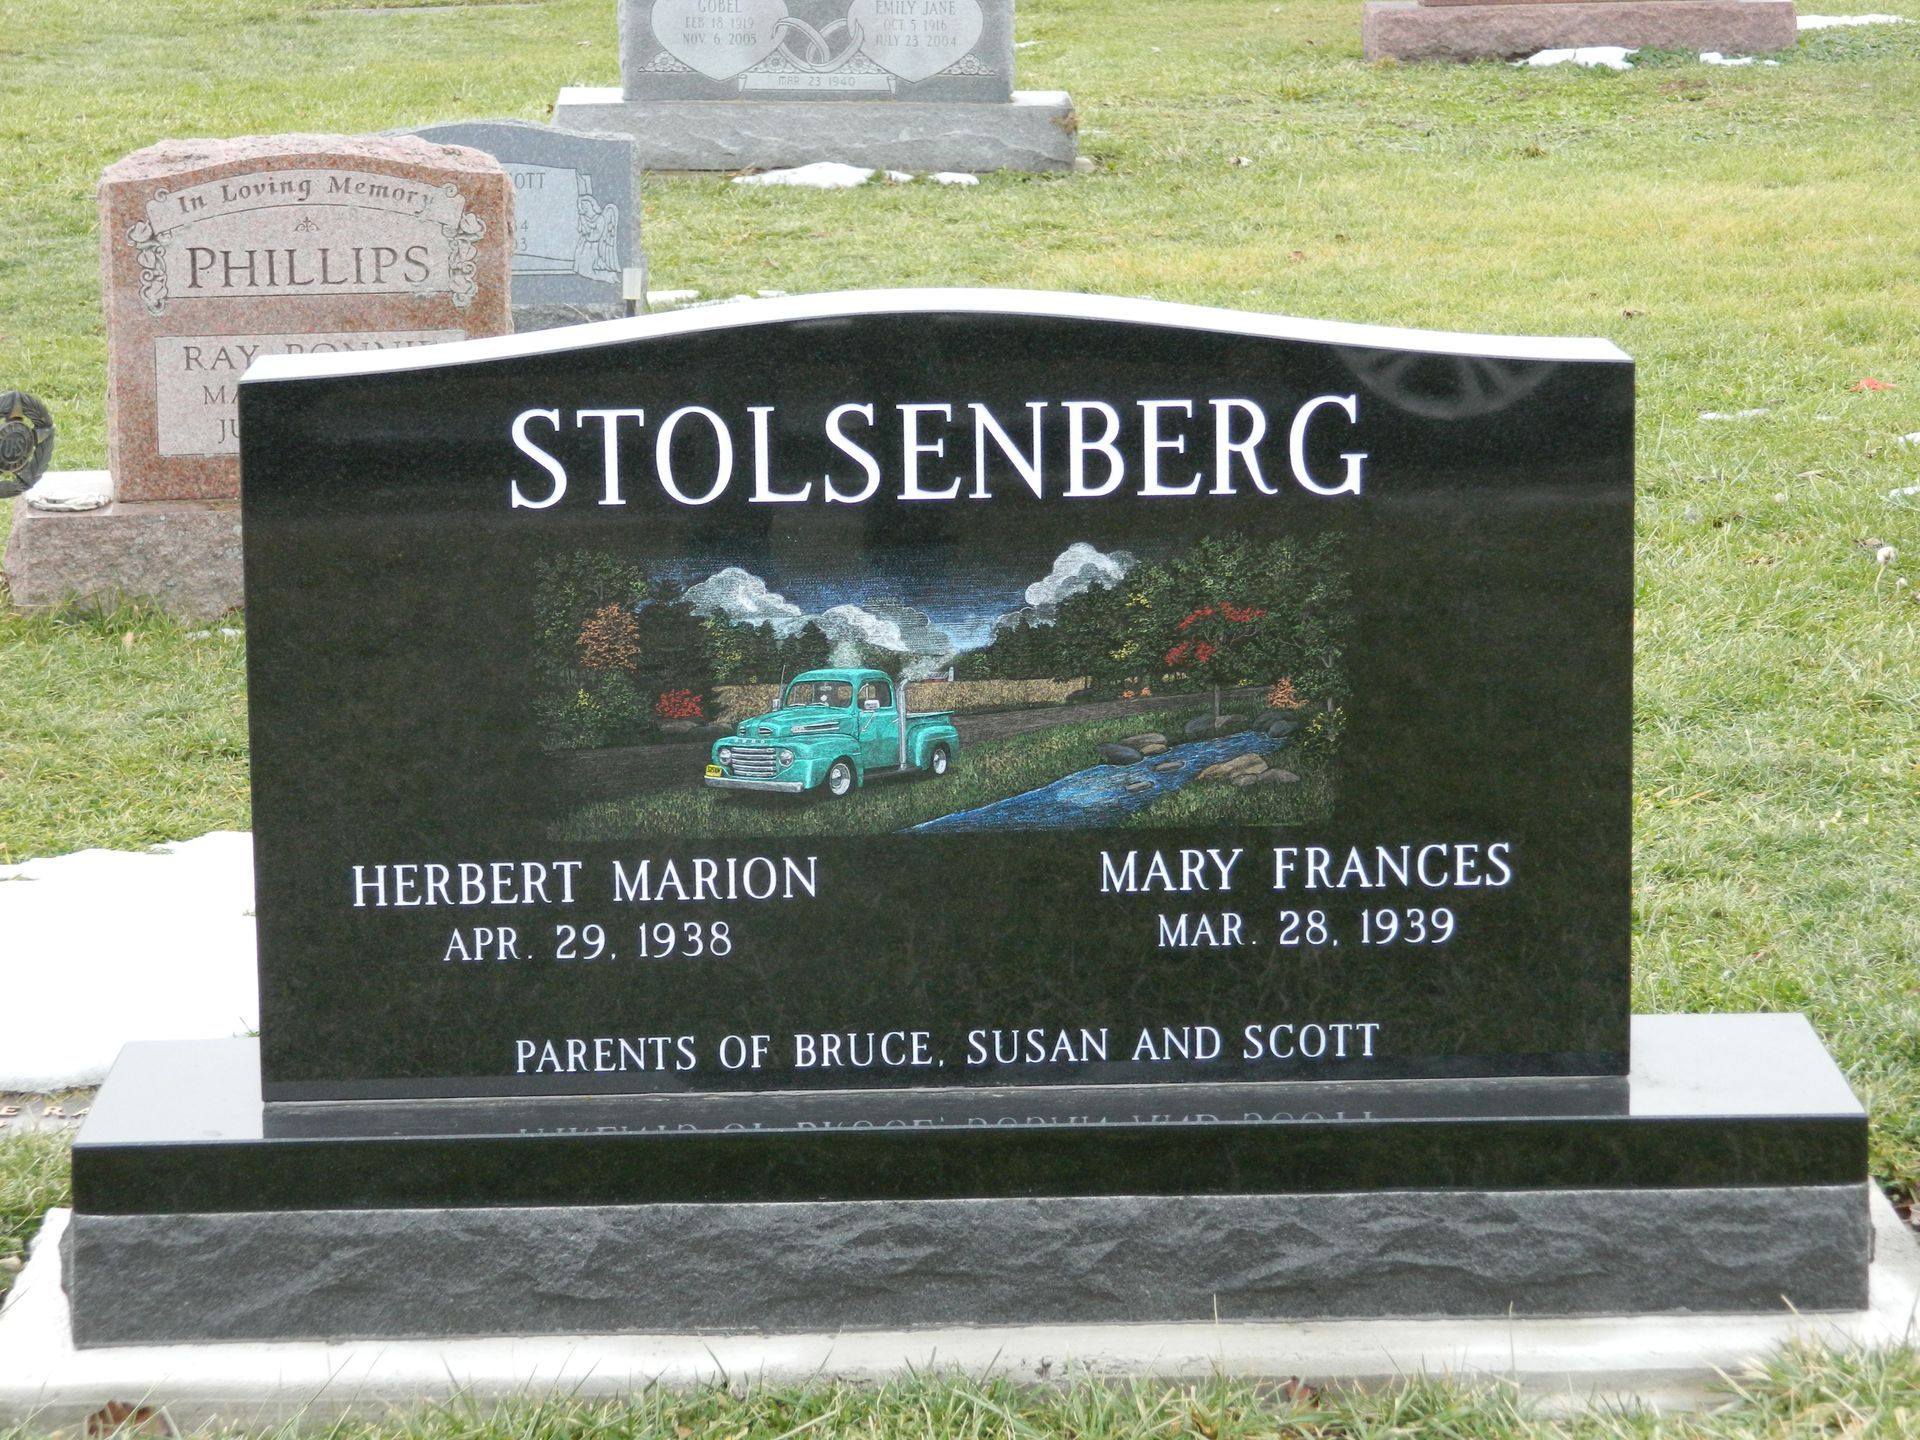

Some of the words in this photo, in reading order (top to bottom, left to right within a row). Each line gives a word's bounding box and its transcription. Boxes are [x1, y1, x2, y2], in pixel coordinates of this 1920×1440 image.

[684, 17, 704, 28] FEB
[883, 19, 904, 31] OCT
[921, 0, 956, 15] JANE
[682, 33, 706, 45] NOV
[713, 34, 720, 45] 6
[728, 34, 757, 45] 2005
[875, 35, 899, 47] JULY
[905, 35, 919, 47] 23
[927, 36, 957, 48] 2004
[778, 76, 800, 85] MAR
[808, 76, 821, 86] 23
[828, 76, 856, 86] 1940
[179, 194, 208, 214] In
[220, 176, 312, 204] Loving
[328, 175, 435, 215] Memory
[510, 172, 546, 190] OTT
[186, 245, 431, 289] PHILLIPS
[512, 394, 1367, 509] STOLSENBERG
[353, 861, 582, 906] HERBERT
[613, 857, 817, 901] MARION
[1101, 849, 1243, 892] MARY
[1273, 843, 1511, 889] FRANCES
[444, 927, 532, 961] APR.
[557, 924, 615, 959] 29,
[640, 921, 731, 958] 1938
[1159, 913, 1257, 947] MAR.
[1280, 910, 1337, 946] 28,
[1362, 908, 1454, 944] 1939
[516, 1036, 696, 1072] PARENTS
[720, 1035, 770, 1068] OF
[794, 1031, 943, 1067] BRUCE,
[968, 1028, 1107, 1064] SUSAN
[1132, 1027, 1220, 1060] AND
[1244, 1024, 1379, 1058] SCOTT
